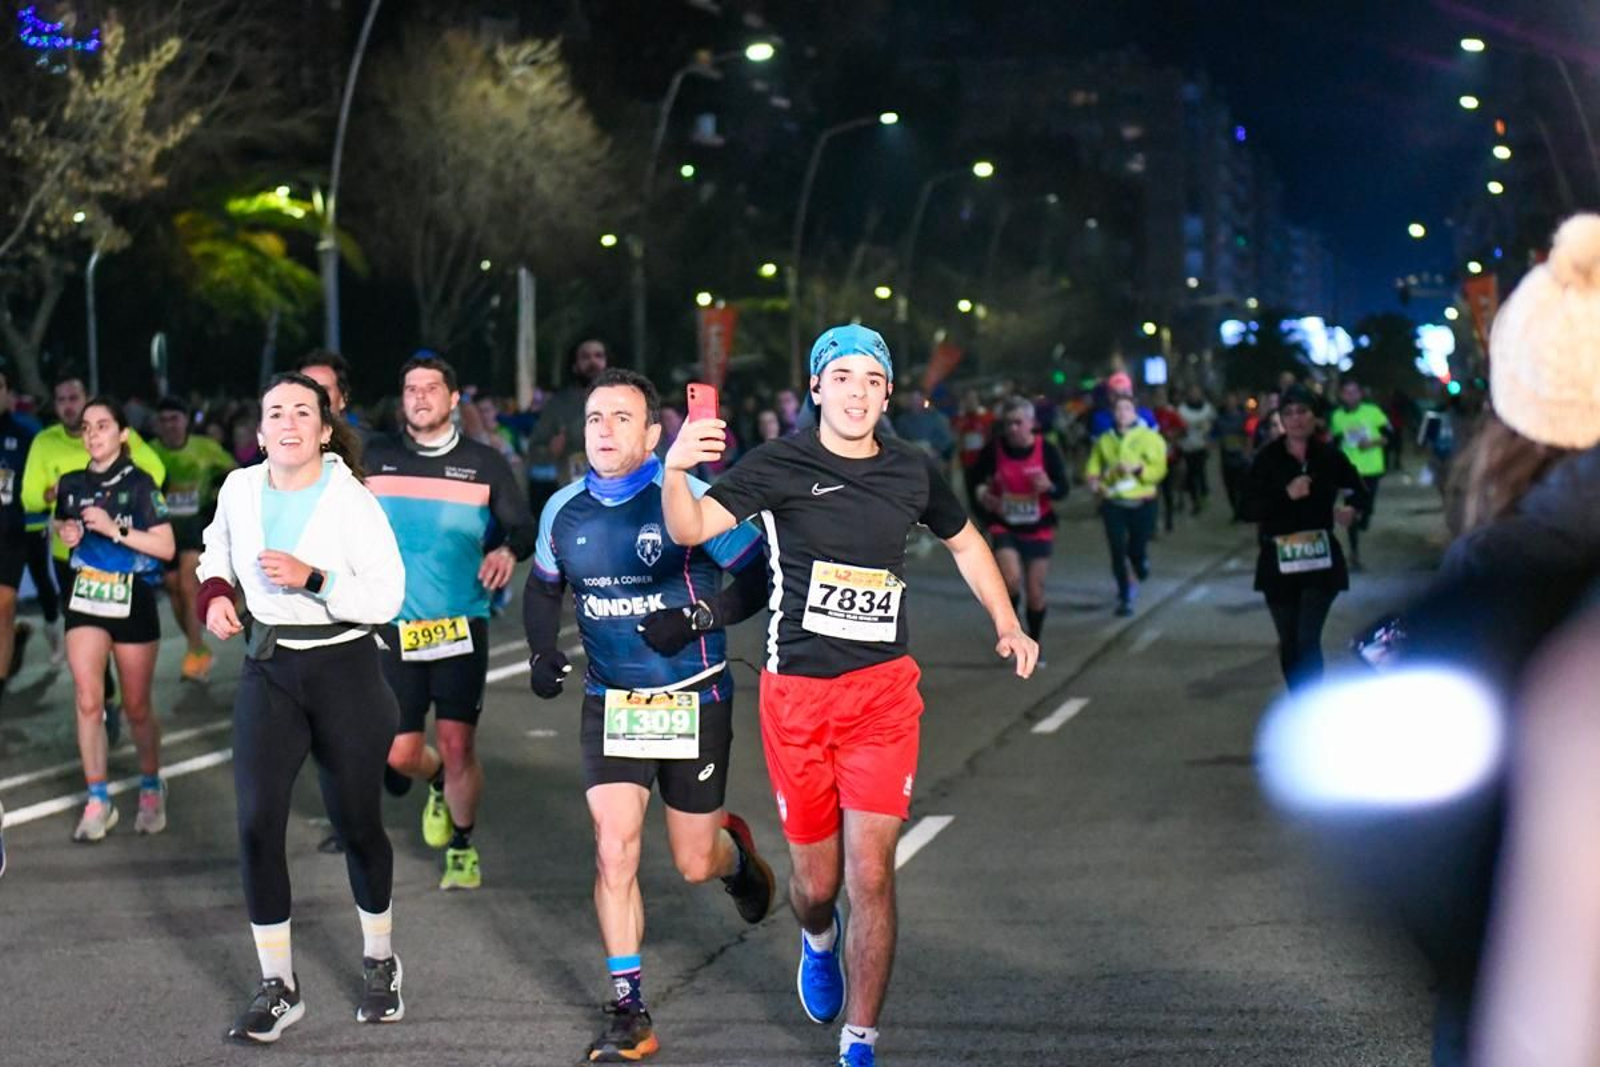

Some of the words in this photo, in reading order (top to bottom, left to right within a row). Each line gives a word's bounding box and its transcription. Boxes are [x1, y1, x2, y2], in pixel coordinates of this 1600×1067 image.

[77, 580, 128, 601] 2719
[613, 577, 620, 585] A
[819, 583, 892, 614] 7834
[407, 620, 459, 647] 3991
[614, 709, 690, 734] 1309
